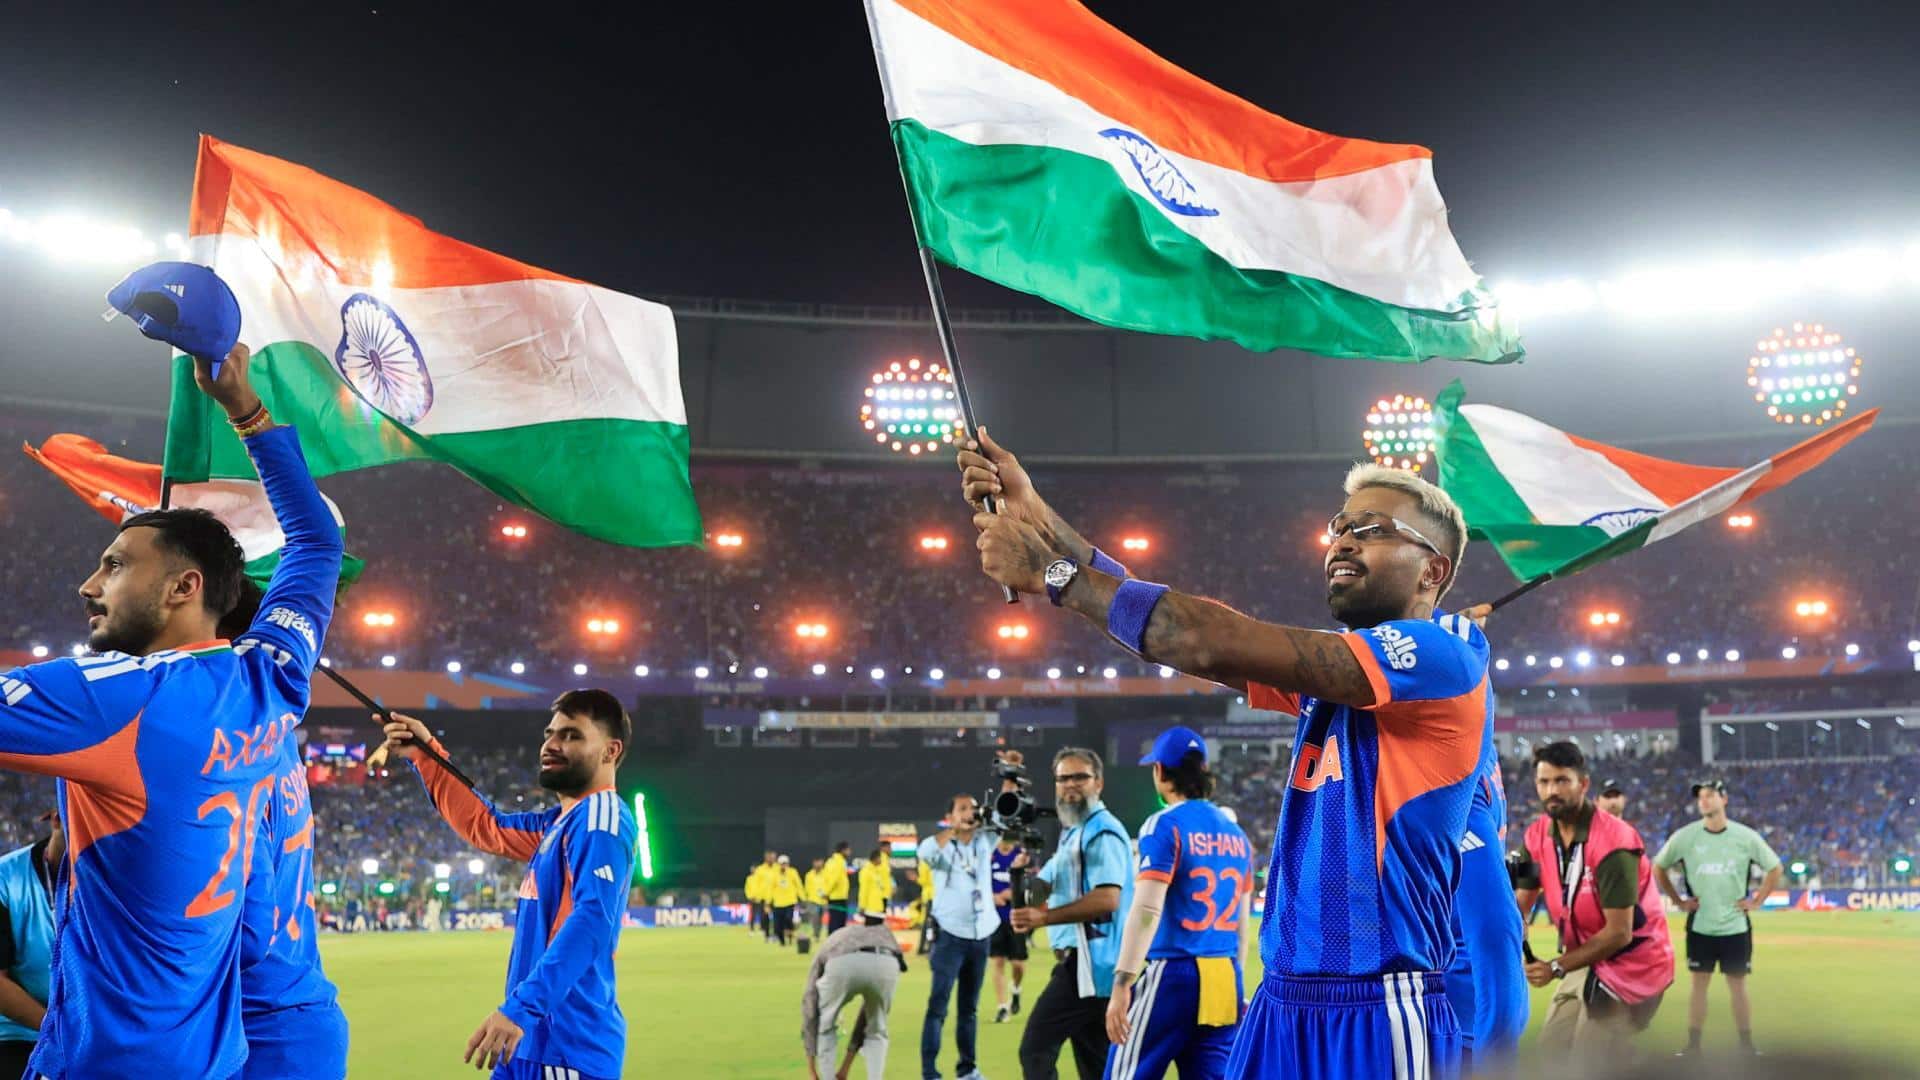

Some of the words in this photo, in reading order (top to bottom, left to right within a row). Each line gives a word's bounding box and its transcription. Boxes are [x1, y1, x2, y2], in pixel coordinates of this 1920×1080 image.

[1371, 624, 1418, 669] pollo
[1188, 831, 1246, 858] ISHAN
[655, 907, 713, 926] INDIA
[1181, 866, 1242, 931] 32
